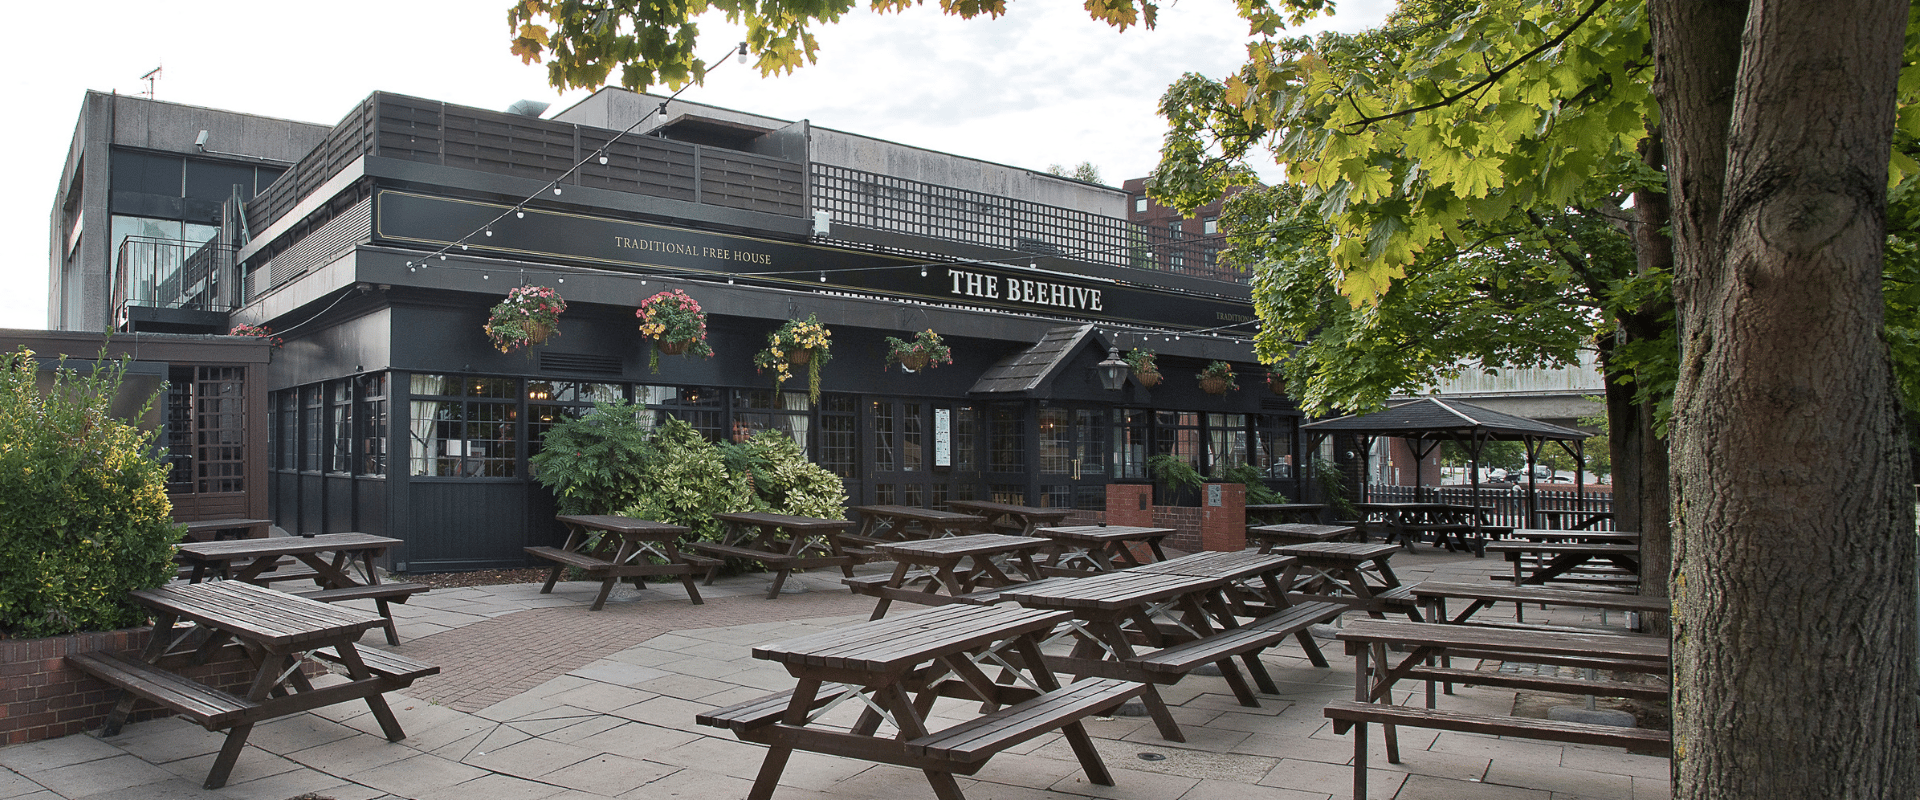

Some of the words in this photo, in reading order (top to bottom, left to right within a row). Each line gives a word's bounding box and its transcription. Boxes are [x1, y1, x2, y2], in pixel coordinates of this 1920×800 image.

[615, 236, 699, 256] TRADITIONAL
[703, 247, 730, 260] FREE
[734, 250, 772, 265] HOUSE
[948, 269, 999, 299] THE
[1006, 278, 1103, 312] BEEHIVE
